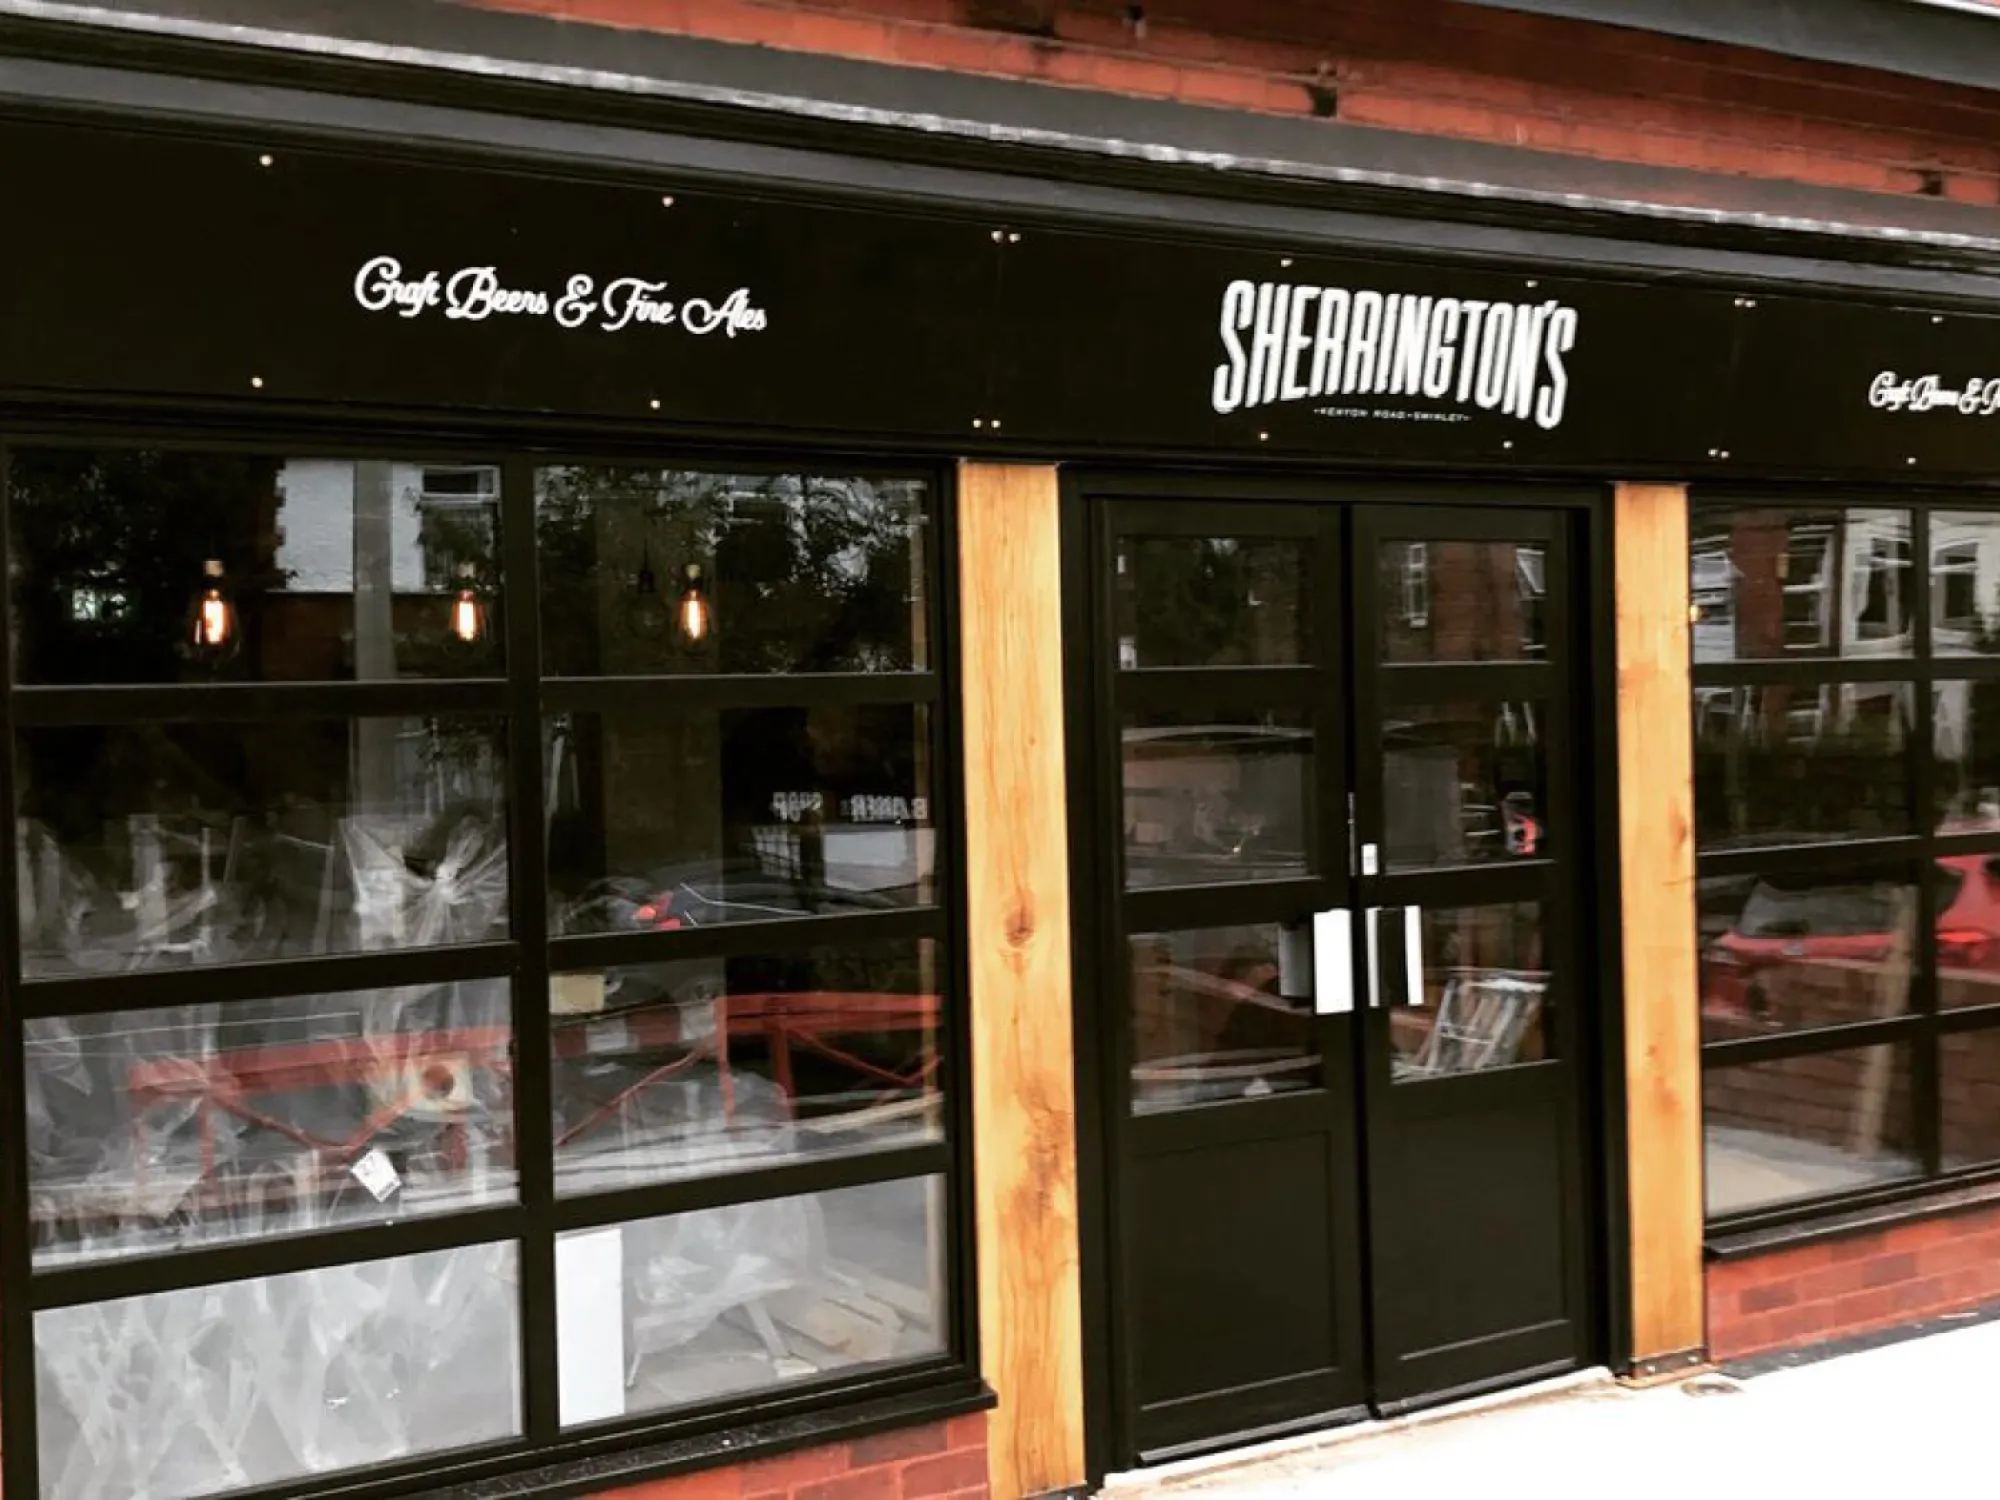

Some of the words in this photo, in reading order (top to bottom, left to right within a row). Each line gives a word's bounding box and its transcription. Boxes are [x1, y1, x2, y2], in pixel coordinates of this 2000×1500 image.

[355, 256, 440, 317] Craft
[446, 266, 549, 320] Beers
[554, 274, 598, 328] &
[601, 278, 676, 332] Fine
[682, 287, 768, 339] Ales
[1212, 280, 1578, 430] SHERRINGTON'S
